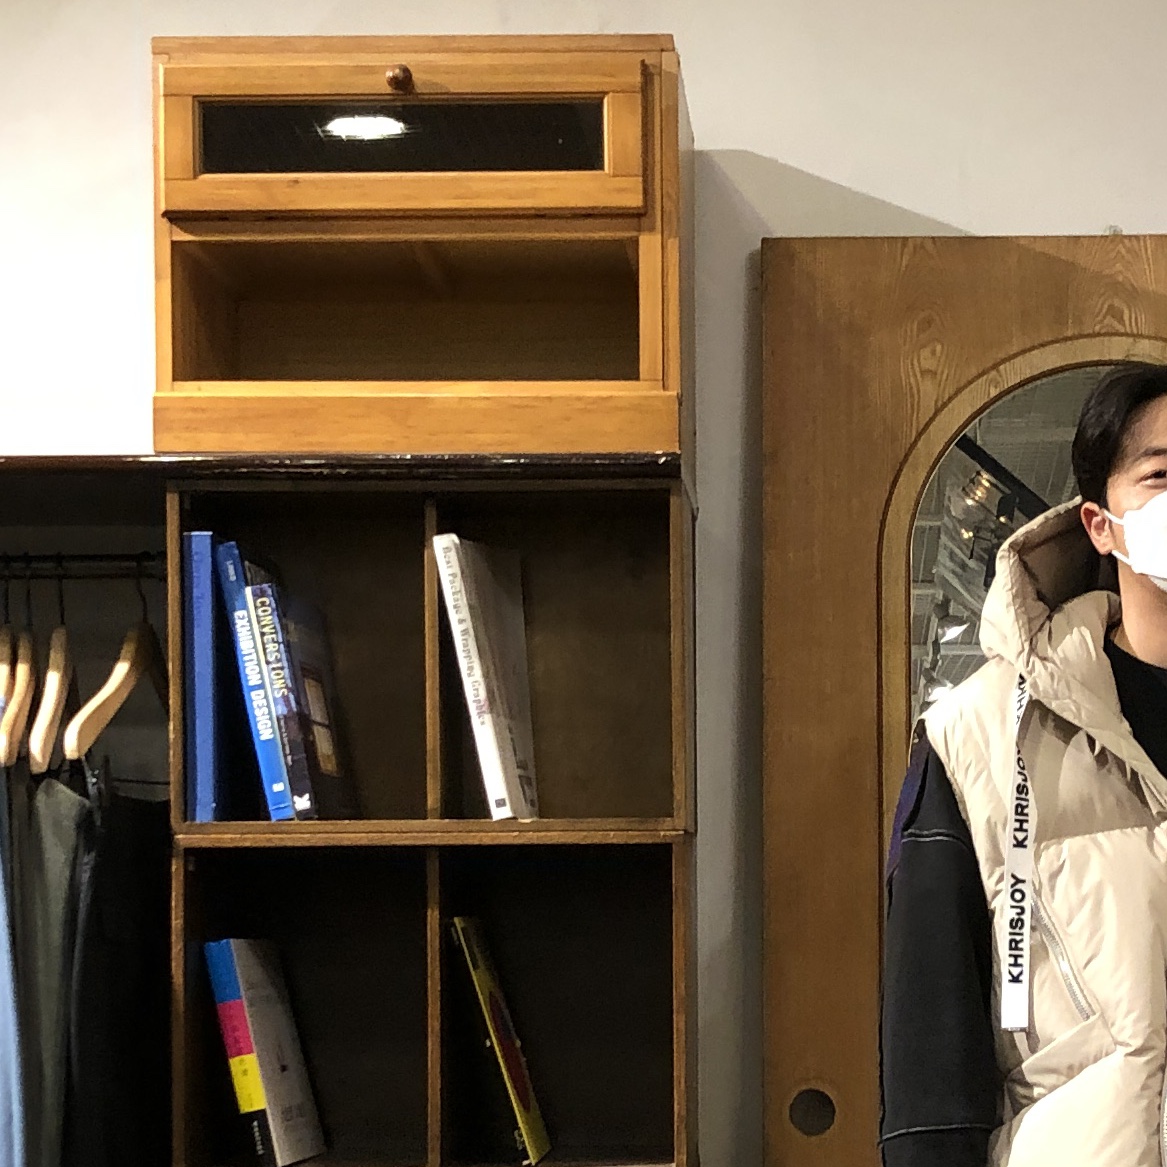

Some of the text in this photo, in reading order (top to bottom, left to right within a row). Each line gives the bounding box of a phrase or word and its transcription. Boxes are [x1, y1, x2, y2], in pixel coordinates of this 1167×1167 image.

[233, 610, 274, 741] EXHIBITION DESIGN
[255, 597, 288, 699] CONVERSIONS
[447, 572, 463, 615] Package
[459, 628, 475, 678] Wrapping
[470, 680, 487, 727] Graphics
[1007, 873, 1028, 984] KHRISJOY
